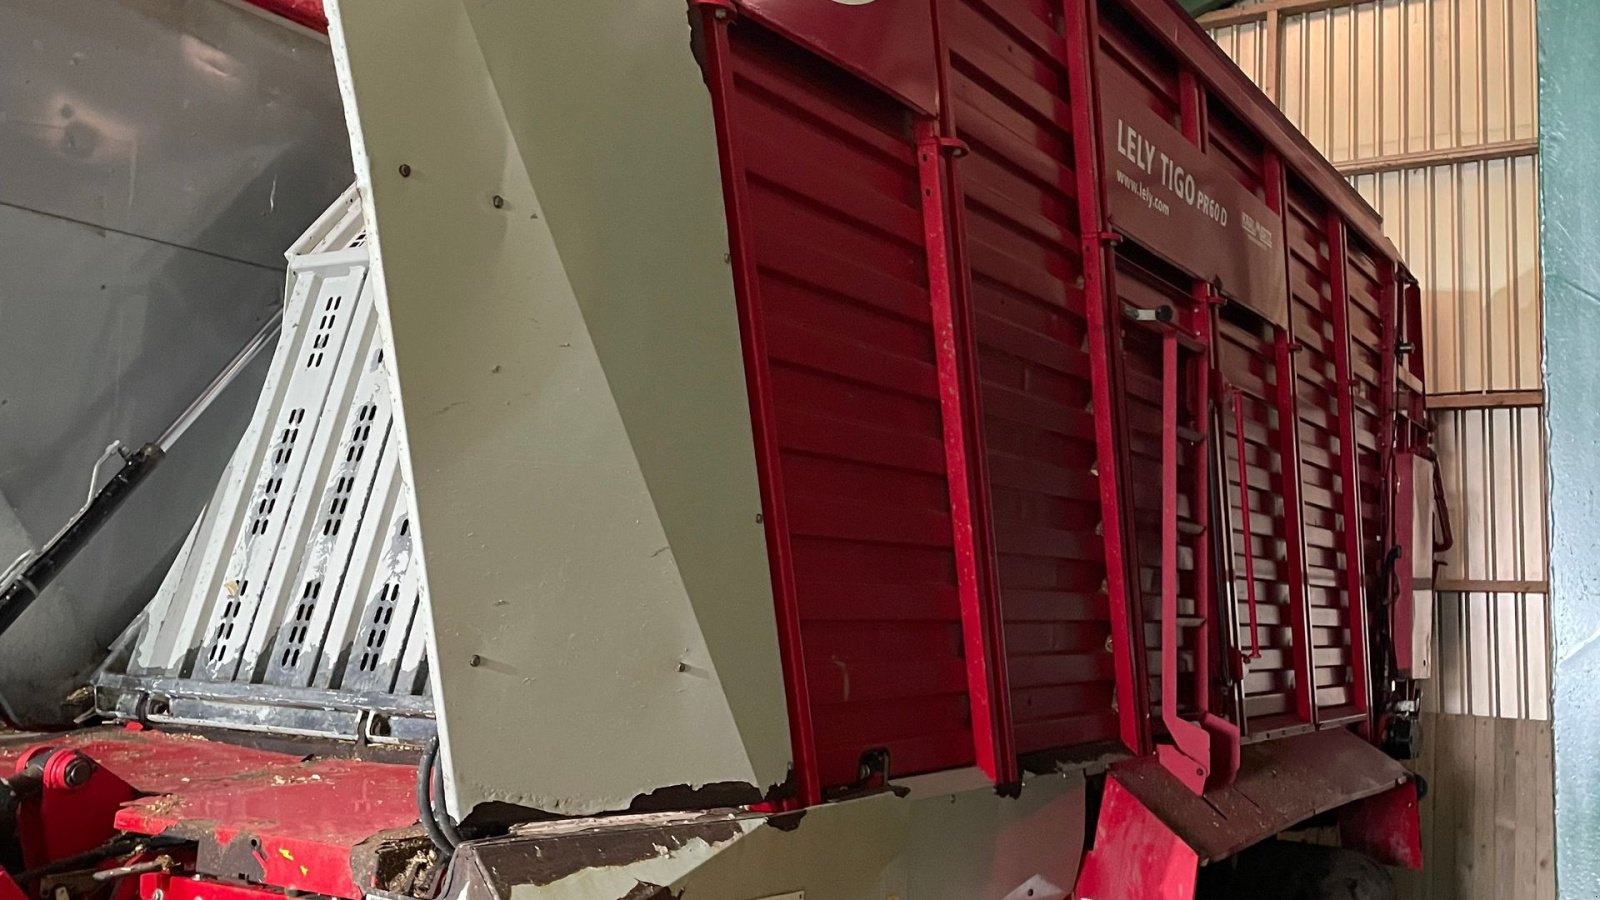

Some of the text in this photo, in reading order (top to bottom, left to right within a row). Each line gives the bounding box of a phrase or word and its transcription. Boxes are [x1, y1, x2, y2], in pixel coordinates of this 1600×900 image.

[1116, 169, 1170, 217] www.lely.com
[1117, 119, 1156, 175] LELY
[1160, 153, 1195, 206] TIGO
